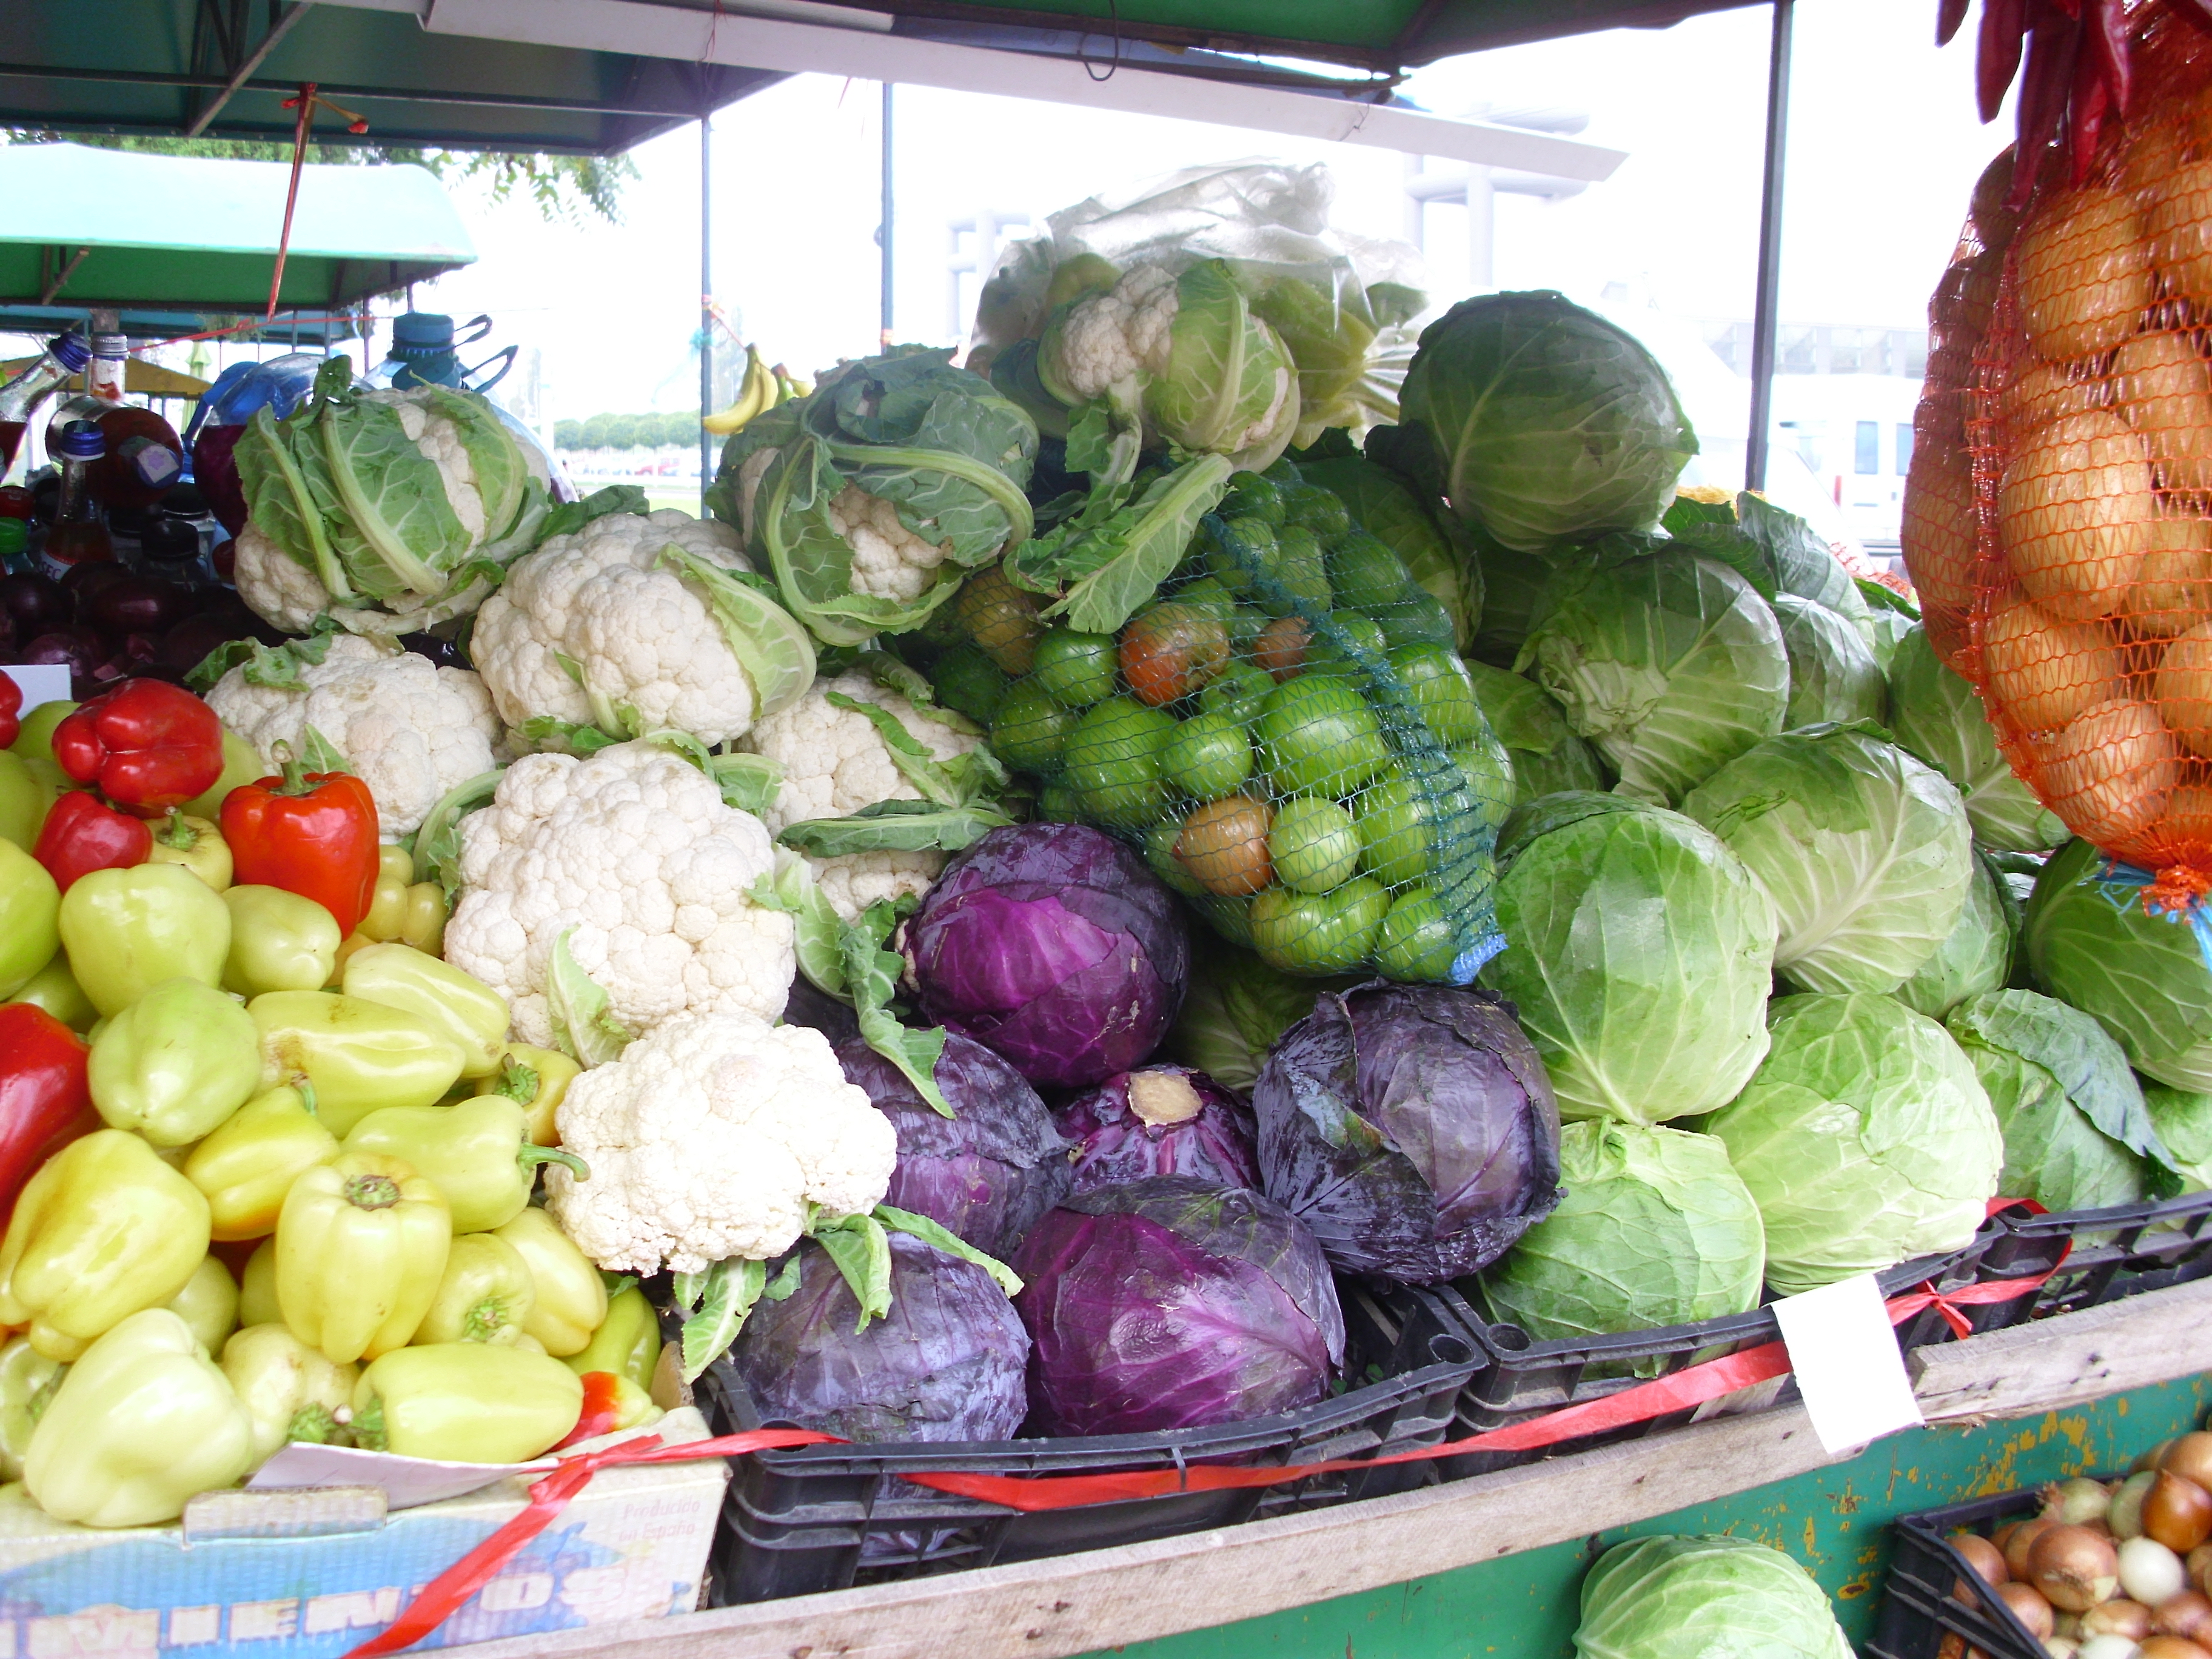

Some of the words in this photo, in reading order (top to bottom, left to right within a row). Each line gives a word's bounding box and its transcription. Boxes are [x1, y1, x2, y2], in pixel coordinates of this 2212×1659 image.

[623, 1495, 701, 1520] Producido
[618, 1529, 638, 1541] en
[642, 1520, 696, 1541] España
